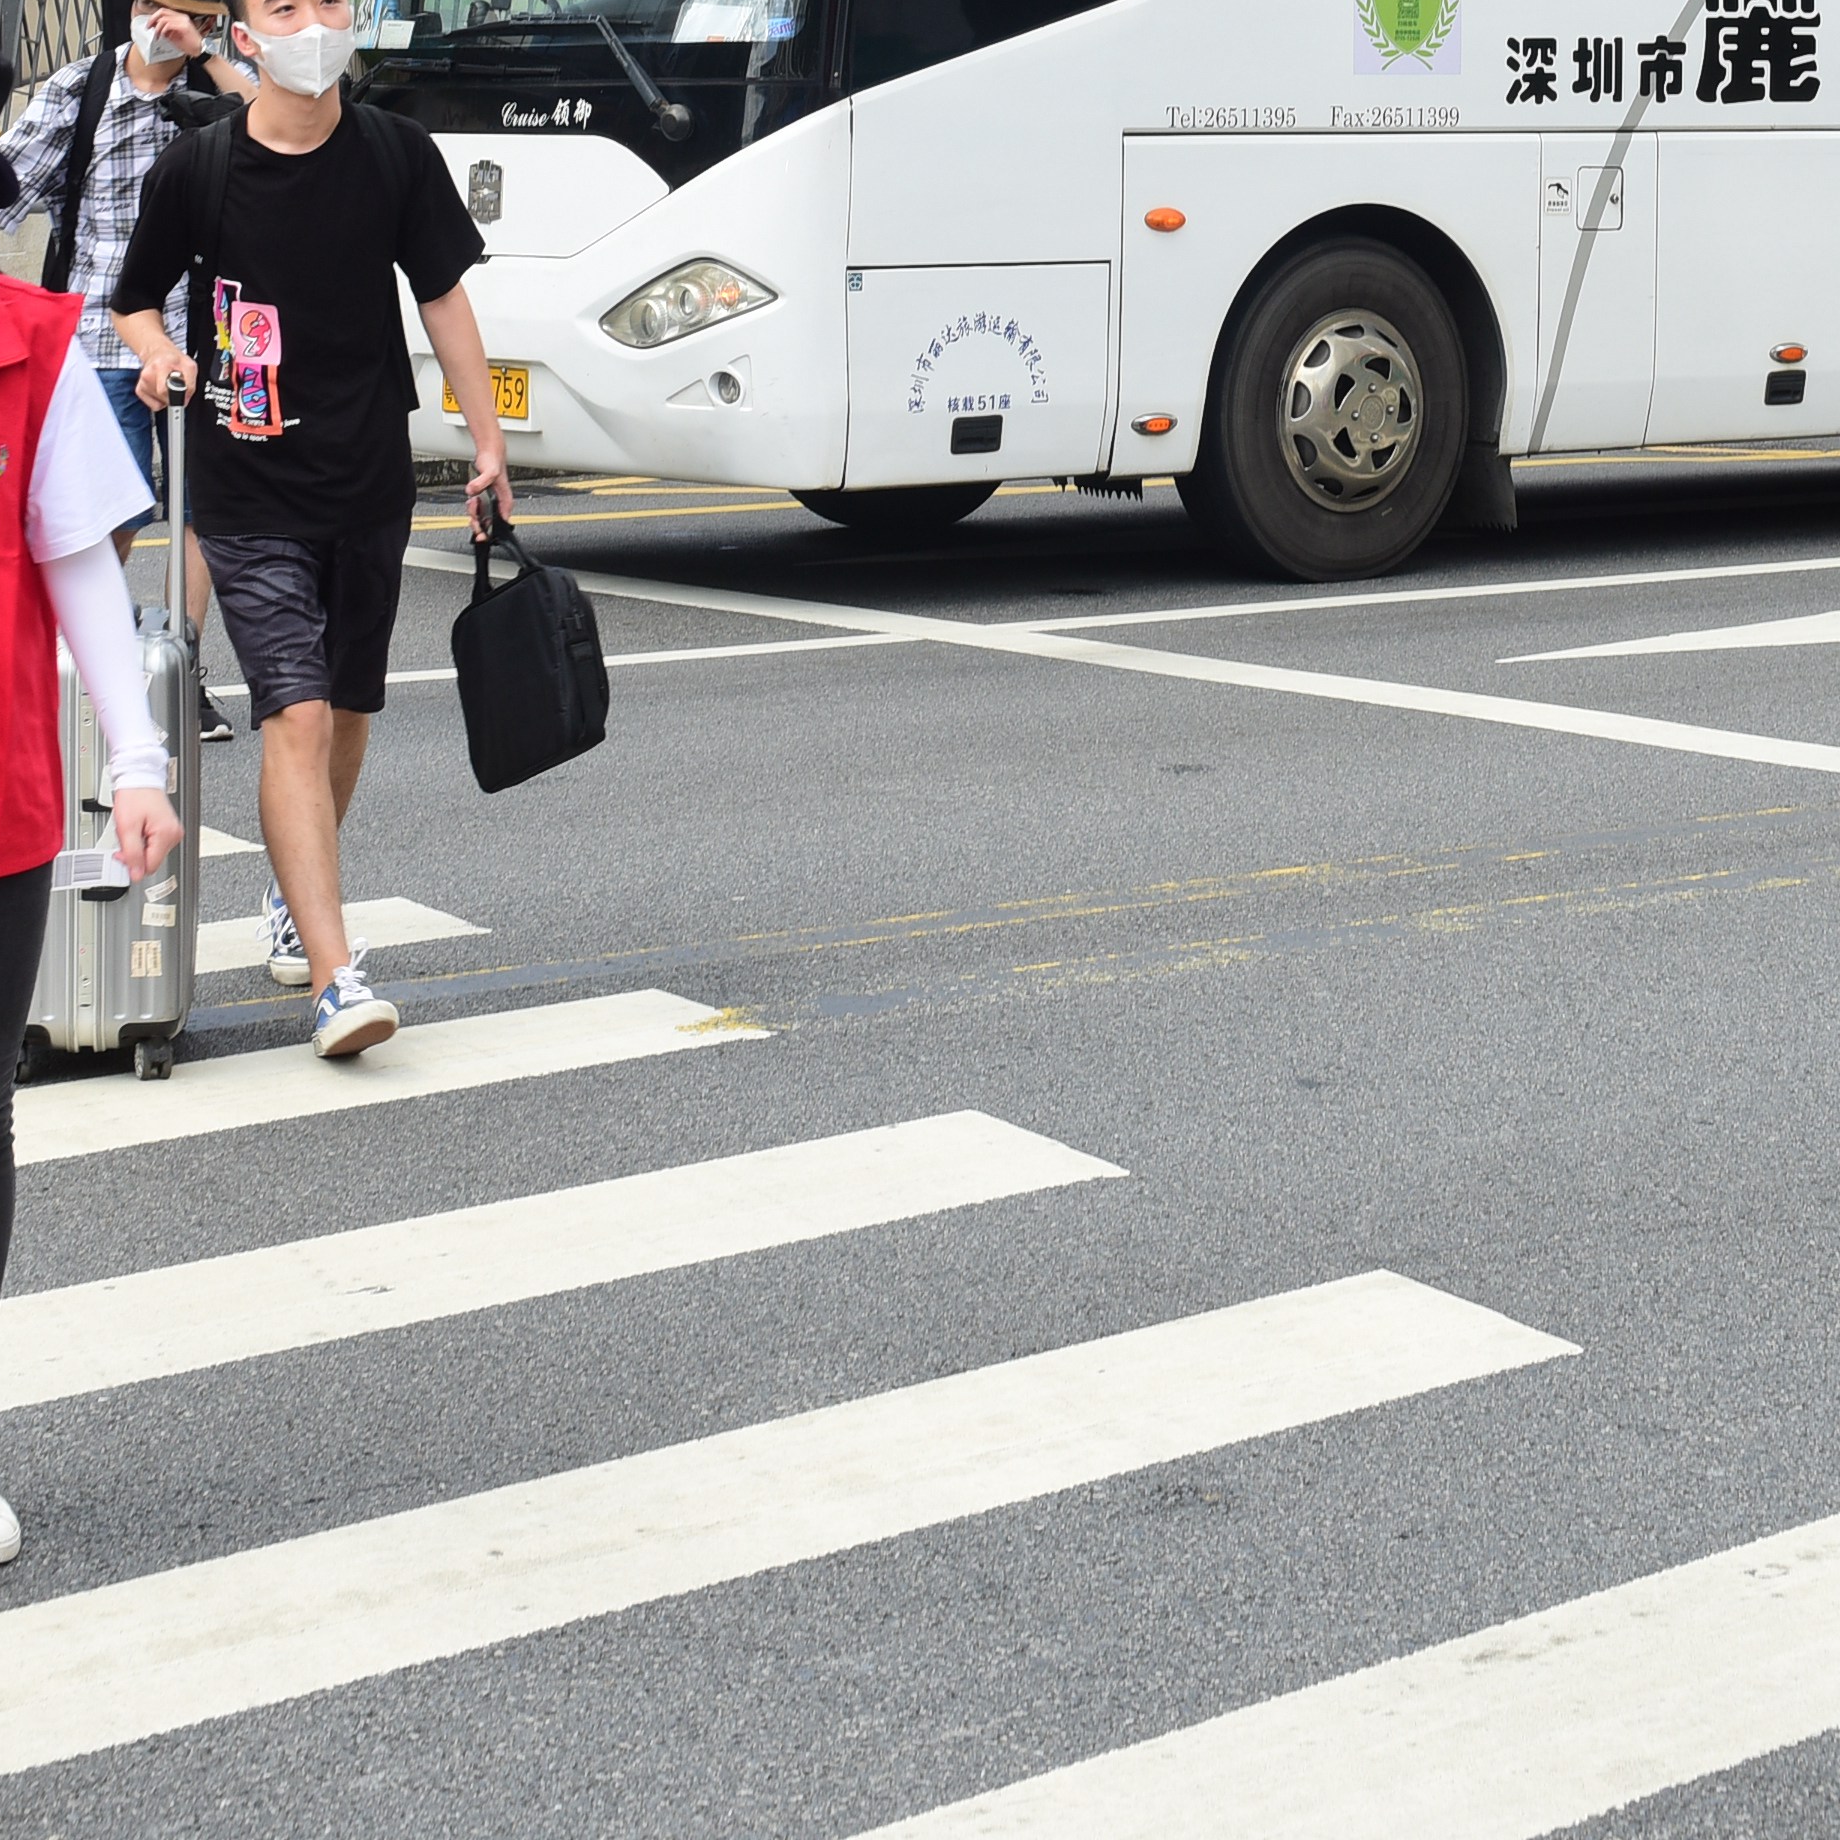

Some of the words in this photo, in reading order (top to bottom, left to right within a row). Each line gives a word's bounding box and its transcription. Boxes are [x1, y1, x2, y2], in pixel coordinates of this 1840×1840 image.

[501, 101, 550, 128] Cruise
[551, 98, 592, 130] 领御
[1165, 106, 1297, 129] Tel:26511395
[1330, 104, 1460, 129] Fax:26511399
[947, 394, 1011, 413] 核载51座
